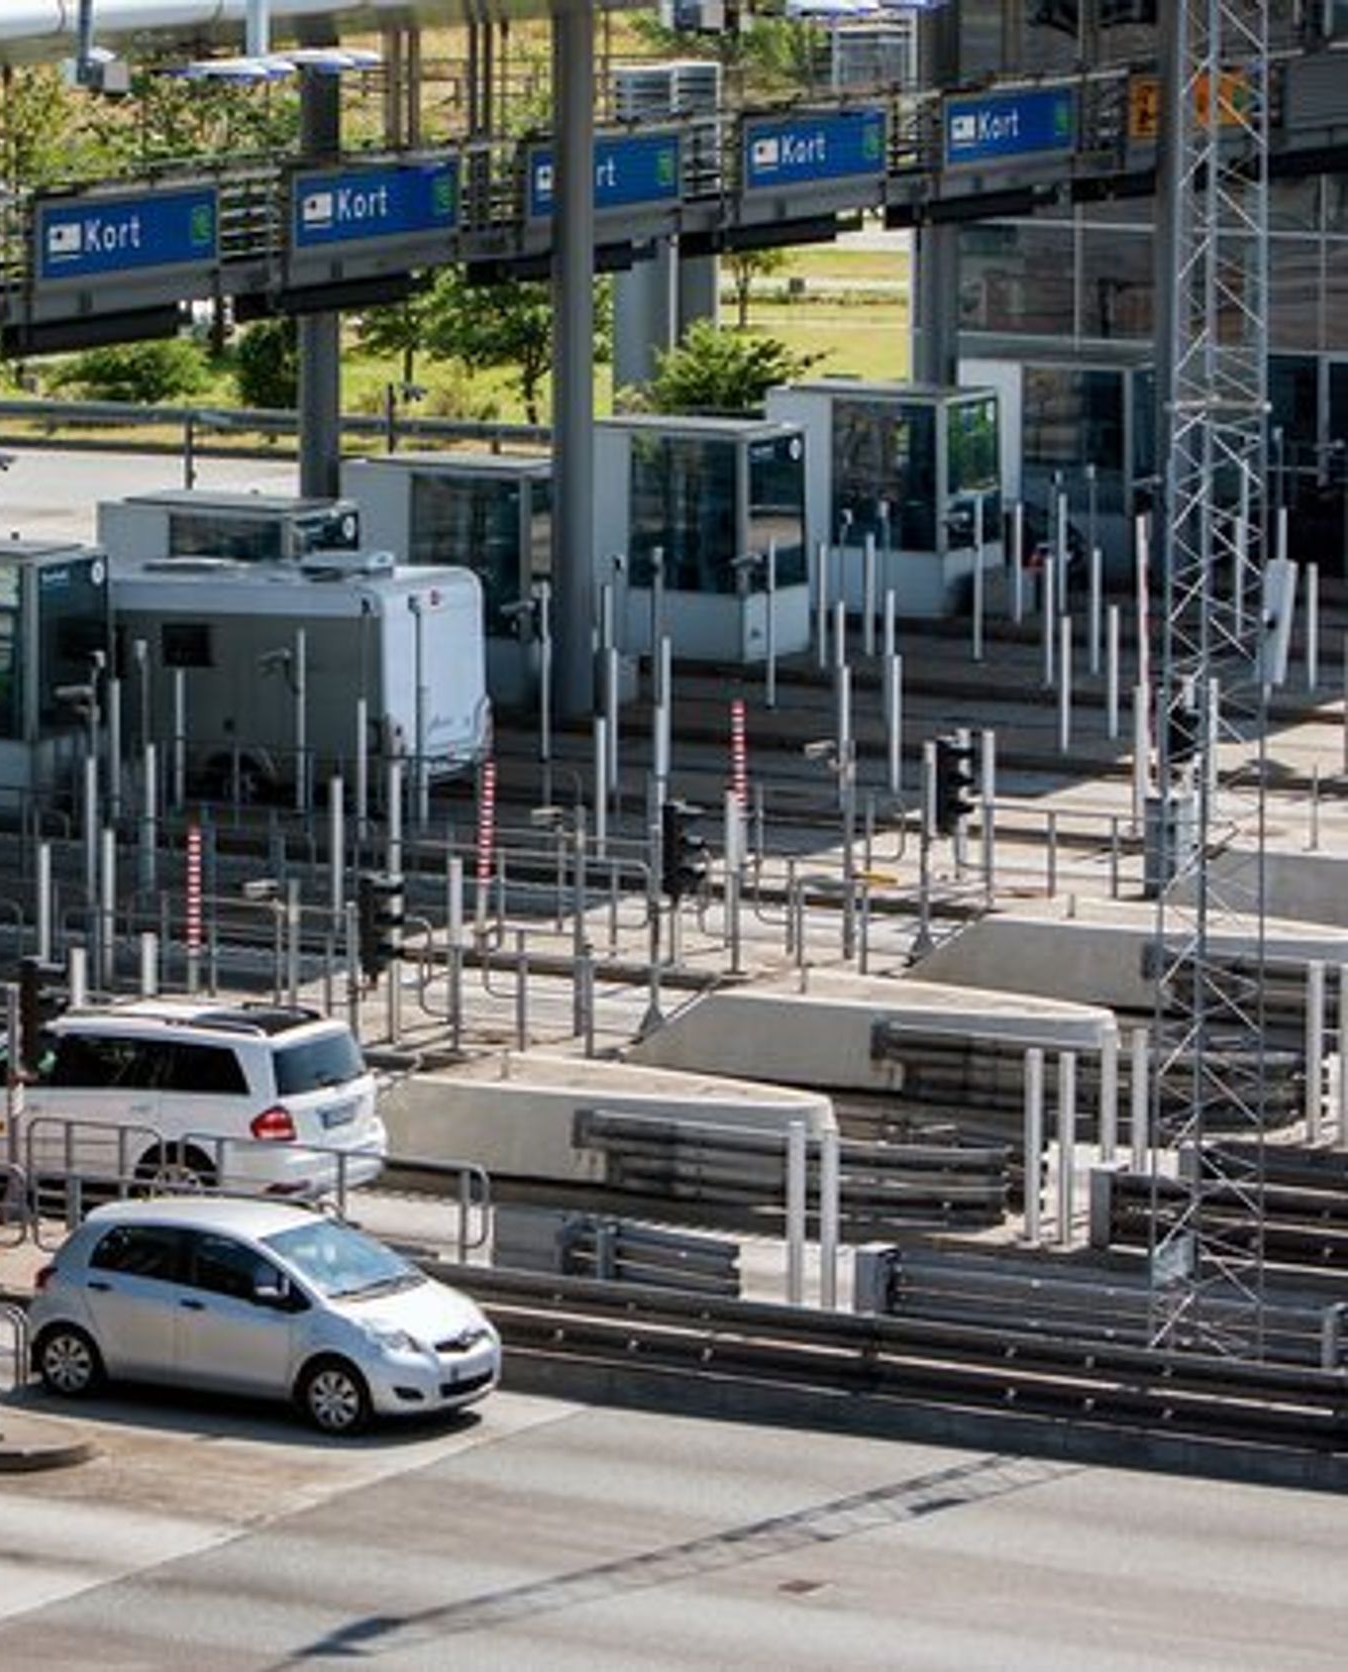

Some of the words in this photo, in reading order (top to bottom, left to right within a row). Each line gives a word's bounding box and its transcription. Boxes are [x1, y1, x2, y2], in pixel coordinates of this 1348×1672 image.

[978, 108, 1019, 139] Kort
[781, 131, 826, 164] Kort
[595, 156, 617, 187] rt
[338, 185, 387, 221] Kort
[84, 214, 140, 251] Kort
